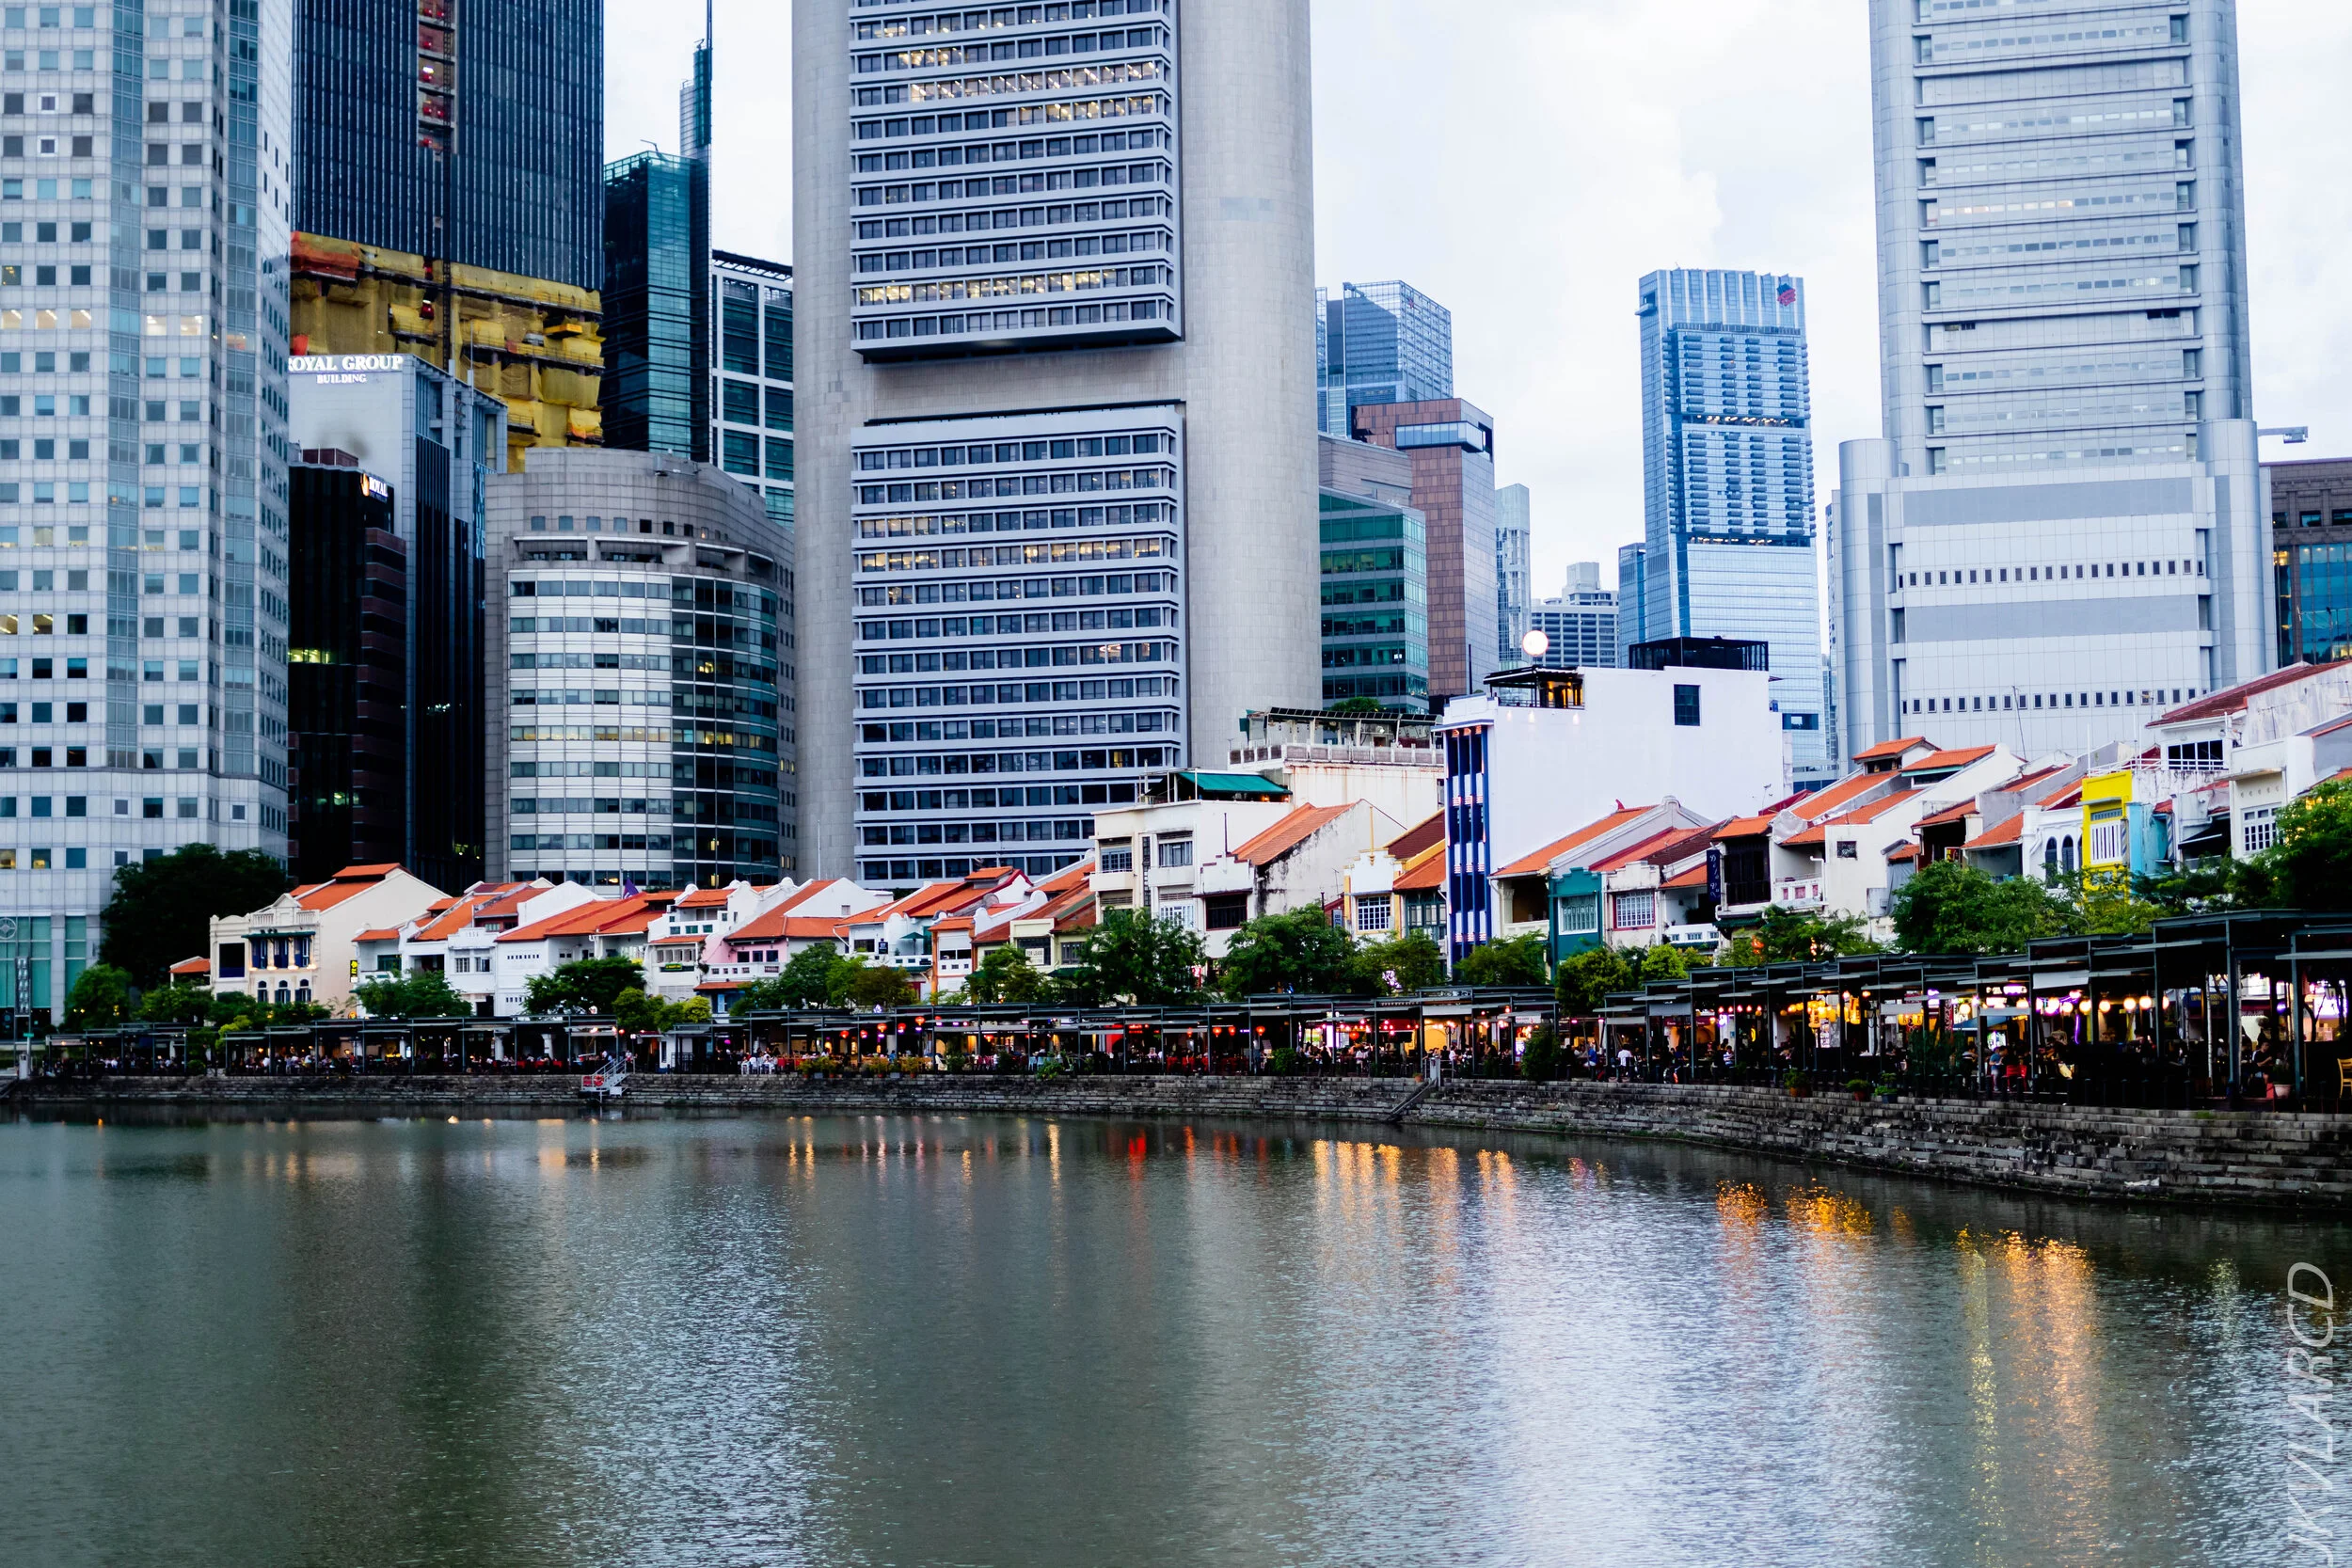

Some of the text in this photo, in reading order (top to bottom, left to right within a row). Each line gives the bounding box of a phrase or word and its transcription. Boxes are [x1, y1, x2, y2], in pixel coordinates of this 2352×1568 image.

[342, 356, 404, 371] GROUP
[316, 373, 367, 384] BUILDING
[369, 476, 389, 498] ROYAL
